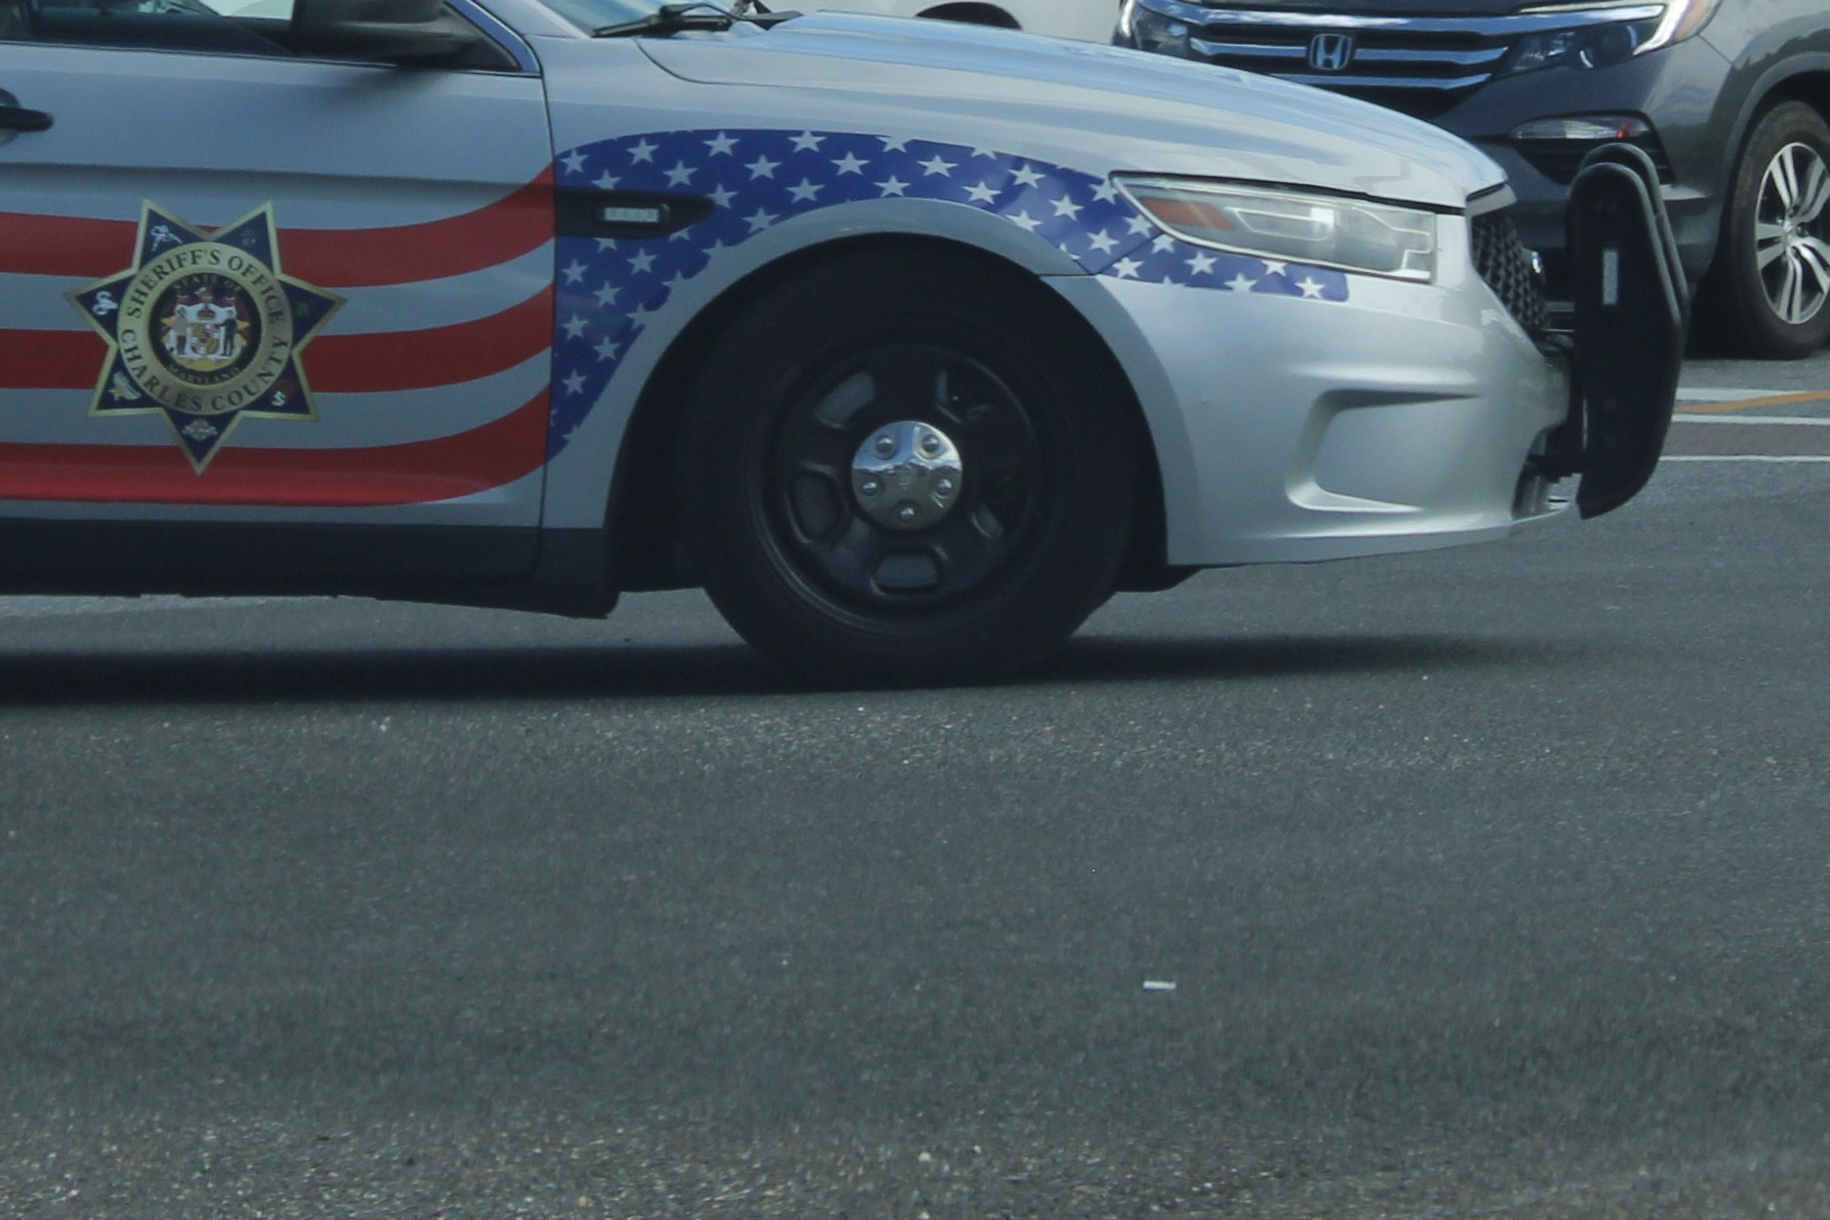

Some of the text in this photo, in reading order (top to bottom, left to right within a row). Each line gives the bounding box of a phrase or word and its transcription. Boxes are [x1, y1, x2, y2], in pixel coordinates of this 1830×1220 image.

[126, 248, 285, 324] SHERIFF'S OFFICE
[121, 328, 290, 412] CHARLES COUNTY
